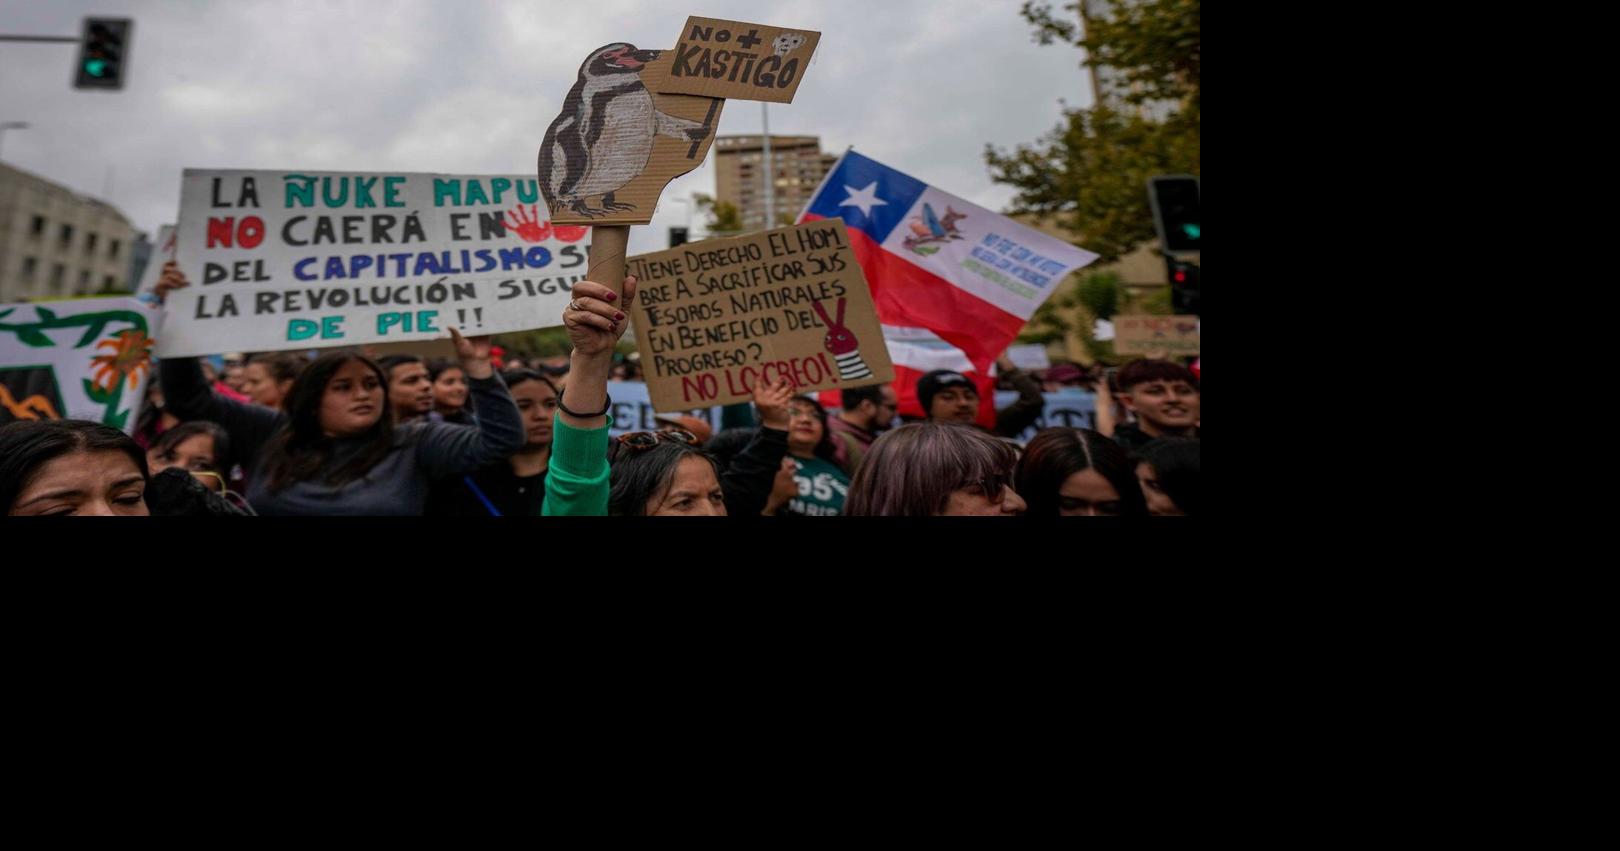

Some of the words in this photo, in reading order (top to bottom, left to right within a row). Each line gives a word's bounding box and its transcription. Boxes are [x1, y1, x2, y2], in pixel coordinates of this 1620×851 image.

[690, 25, 731, 43] NO
[211, 176, 260, 208] LA
[283, 174, 407, 208] ÑUKE
[434, 178, 539, 207] MAPU
[206, 215, 265, 249] NO
[281, 210, 426, 247] CAERÁ
[450, 211, 508, 242] EN
[203, 259, 271, 285] DEL
[293, 246, 553, 280] CAPITALISMO
[560, 245, 592, 269] S
[684, 243, 762, 273] DERECHO
[768, 232, 797, 257] EL
[194, 293, 239, 320] LA
[255, 276, 477, 315] REVOLUCIÓN
[498, 273, 588, 300] SIGU
[639, 285, 672, 306] BRE
[676, 278, 694, 300] A
[806, 252, 847, 275] SUS
[643, 300, 724, 327] TESOROS
[730, 279, 847, 315] NATURALES
[286, 315, 345, 341] DE
[376, 309, 440, 335] PIE
[648, 329, 676, 354] EN
[677, 316, 779, 350] BENEFICIO
[784, 309, 825, 332] DEL
[681, 372, 720, 402] NO
